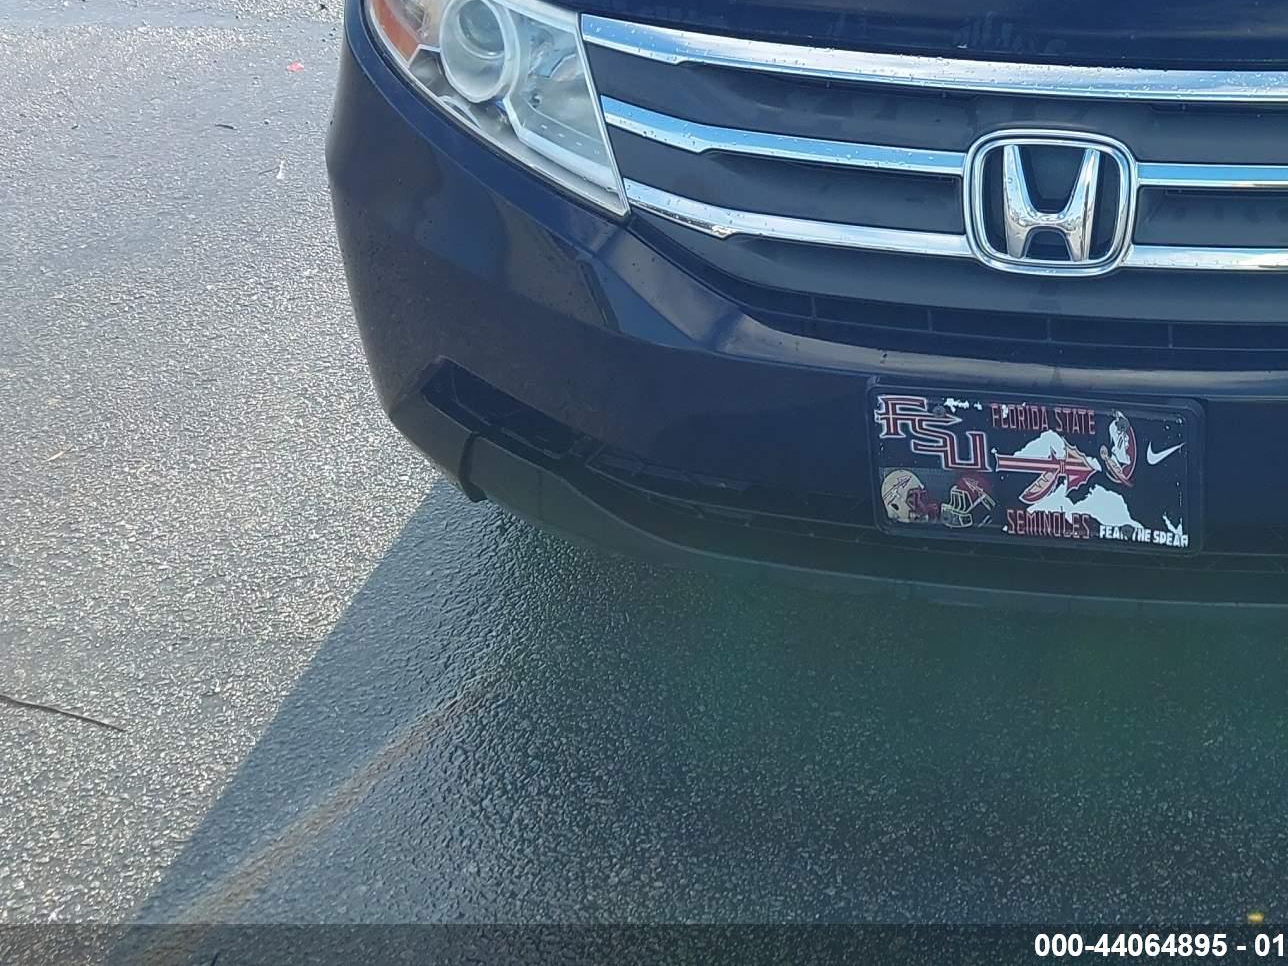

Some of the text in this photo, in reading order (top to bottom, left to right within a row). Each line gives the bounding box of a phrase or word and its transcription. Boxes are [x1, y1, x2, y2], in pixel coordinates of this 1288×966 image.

[874, 394, 992, 472] FSU
[991, 402, 1096, 434] FLORIDA STATE
[1007, 508, 1091, 539] SEMINOLES
